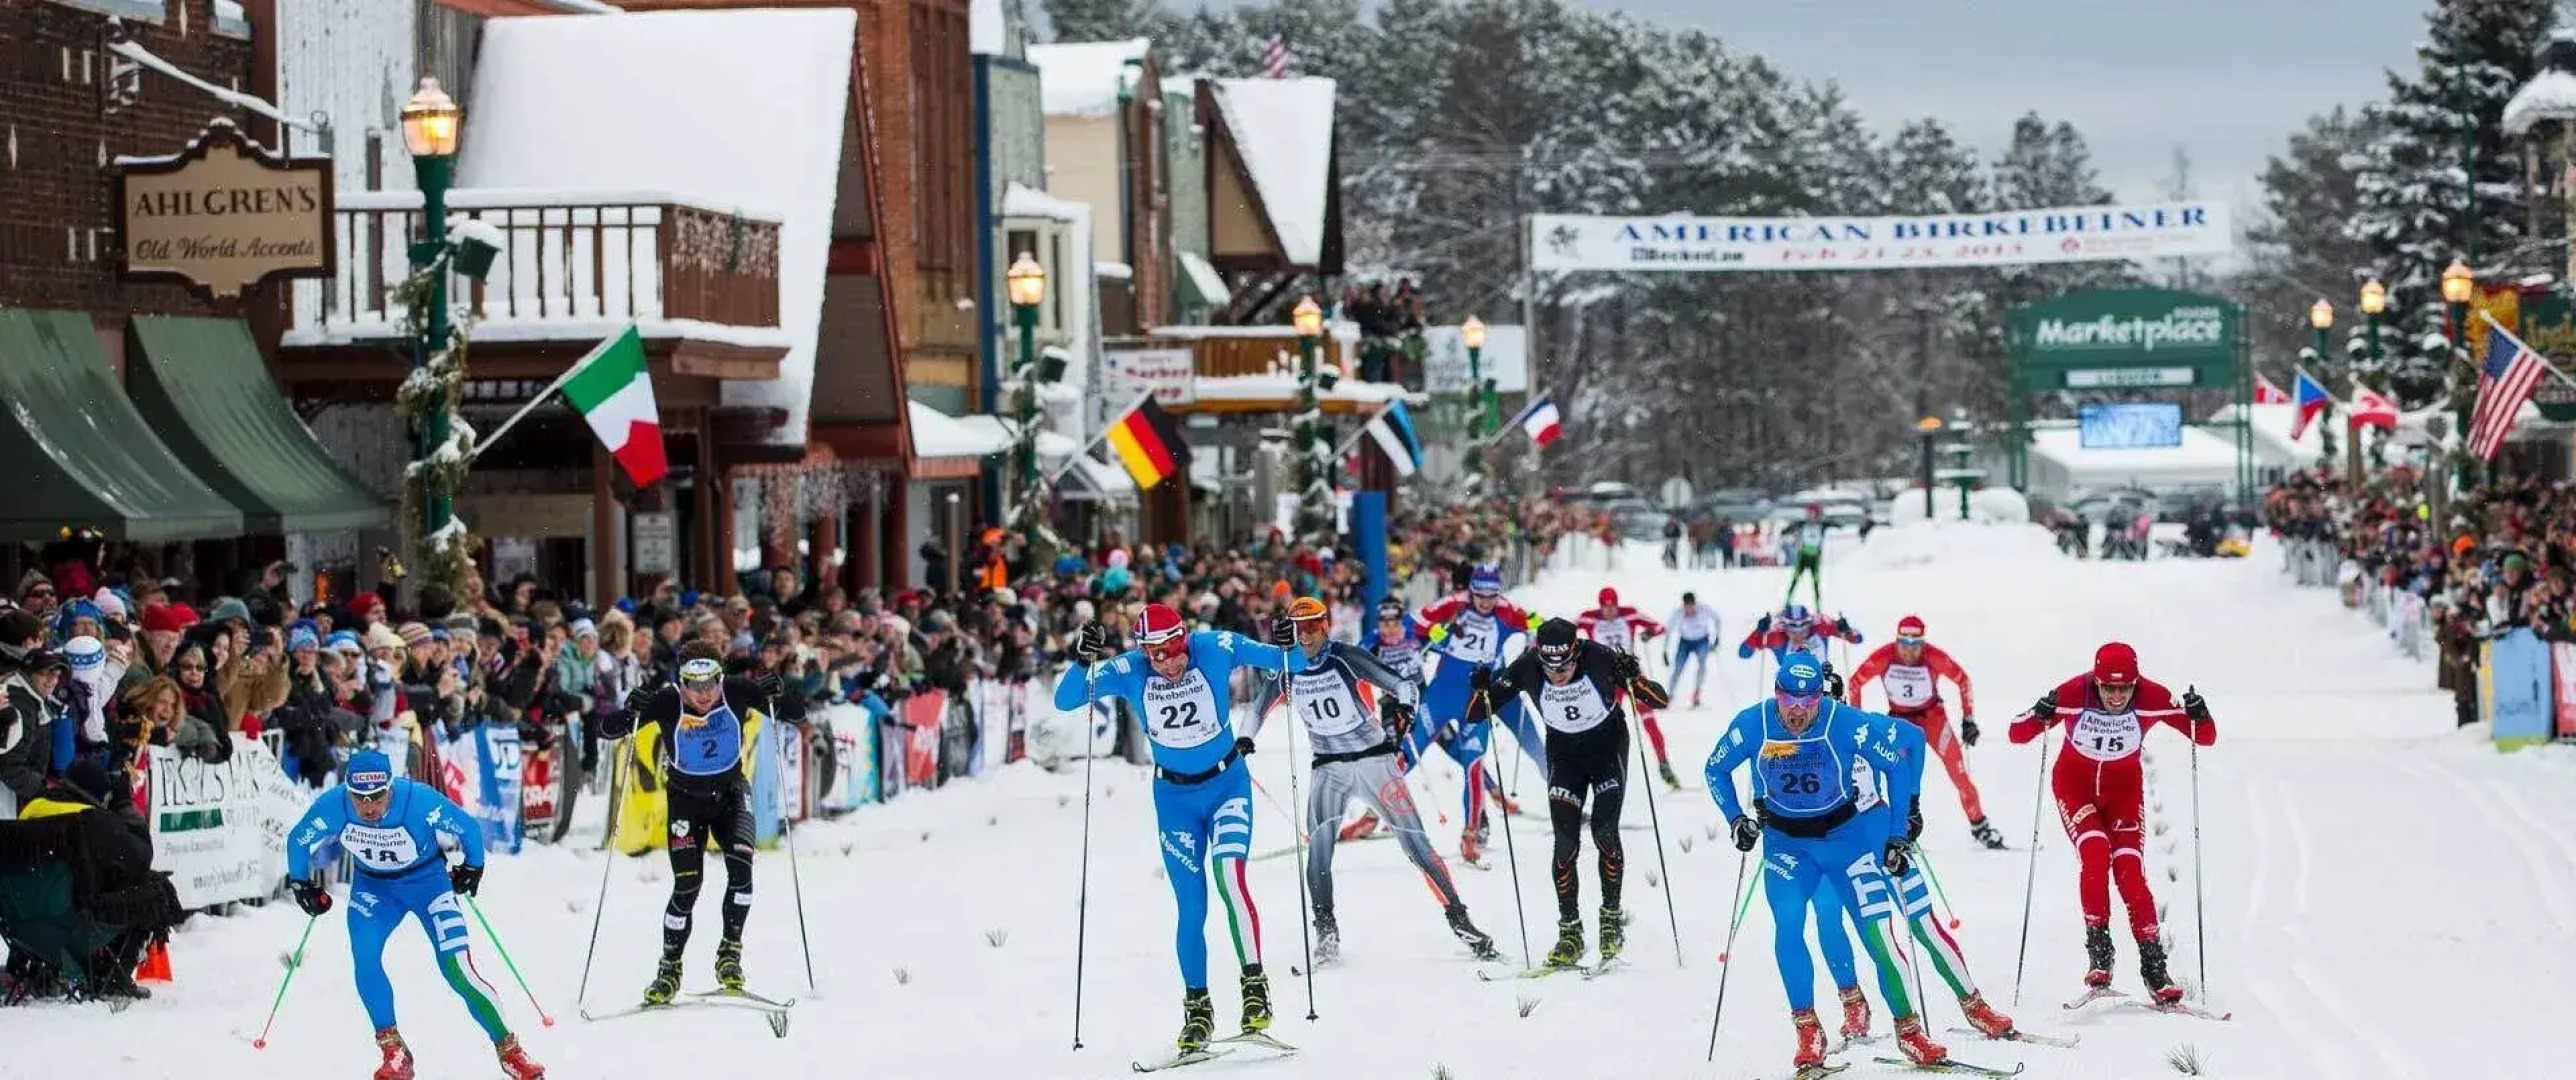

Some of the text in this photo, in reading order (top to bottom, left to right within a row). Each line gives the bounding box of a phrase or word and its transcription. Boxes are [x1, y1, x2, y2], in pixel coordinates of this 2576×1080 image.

[133, 185, 316, 216] AHLGREN'S
[1614, 208, 2208, 242] AMERICAN BIRKEBEINER
[136, 236, 315, 260] Old World Accents
[2036, 314, 2222, 352] Marketplace
[1464, 633, 1486, 651] 21
[1541, 644, 1569, 653] ATLAS
[1902, 684, 1914, 699] 3
[1160, 701, 1201, 730] 22
[1309, 697, 1341, 721] 10
[1563, 705, 1581, 721] 8
[701, 739, 718, 759] 2
[1872, 741, 1900, 765] Audi
[2092, 736, 2125, 752] 15
[1779, 772, 1821, 794] 26
[1212, 796, 1250, 857] ITA
[359, 848, 399, 863] 18
[1846, 851, 1893, 919] ITA
[427, 890, 470, 952] ITA
